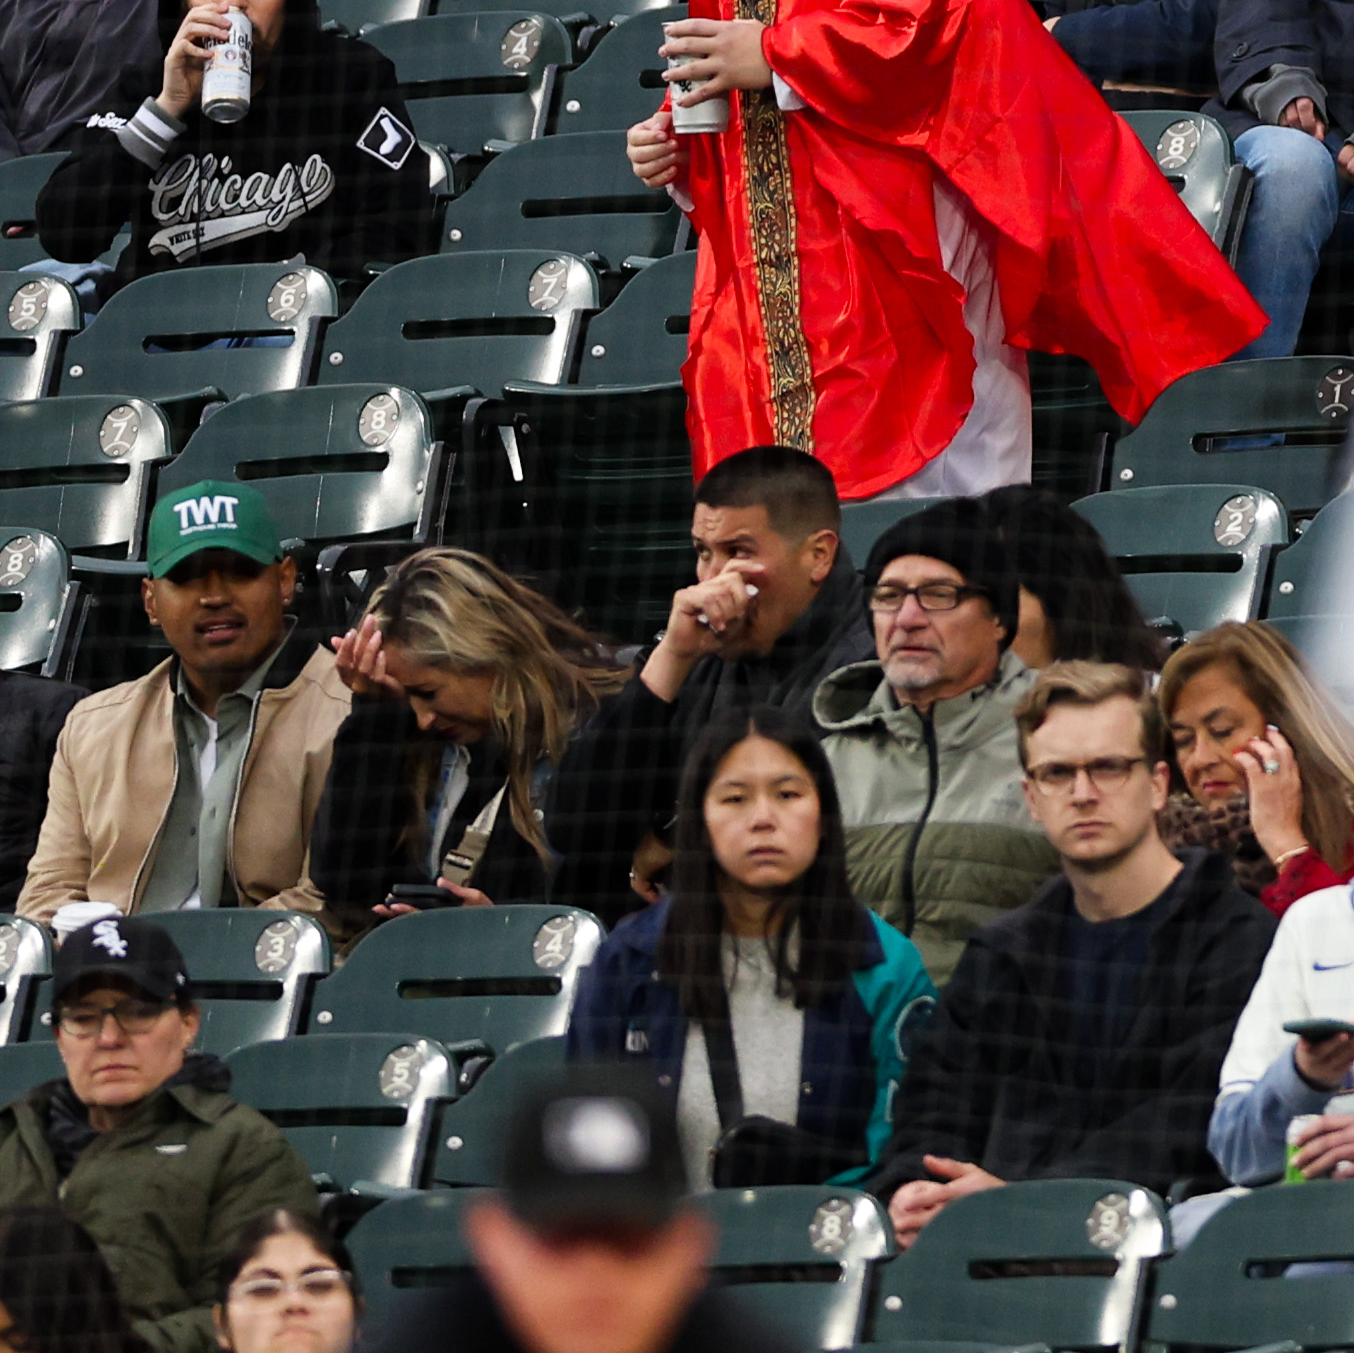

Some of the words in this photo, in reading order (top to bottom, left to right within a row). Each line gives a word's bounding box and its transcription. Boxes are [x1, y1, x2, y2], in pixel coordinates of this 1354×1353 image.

[512, 36, 527, 54] 4
[1170, 136, 1185, 154] 8
[148, 153, 335, 228] Chicago
[543, 278, 557, 296] 7
[21, 298, 36, 316] 5
[281, 289, 295, 307] 6
[372, 410, 385, 429] 8
[113, 422, 127, 441] 7
[173, 495, 239, 529] TWT
[1226, 512, 1242, 531] 2
[8, 553, 22, 571] 8
[268, 938, 284, 958] 3
[546, 933, 562, 952] 4
[392, 1063, 409, 1082] 5
[822, 1216, 841, 1237] 8
[1100, 1211, 1119, 1232] 9
